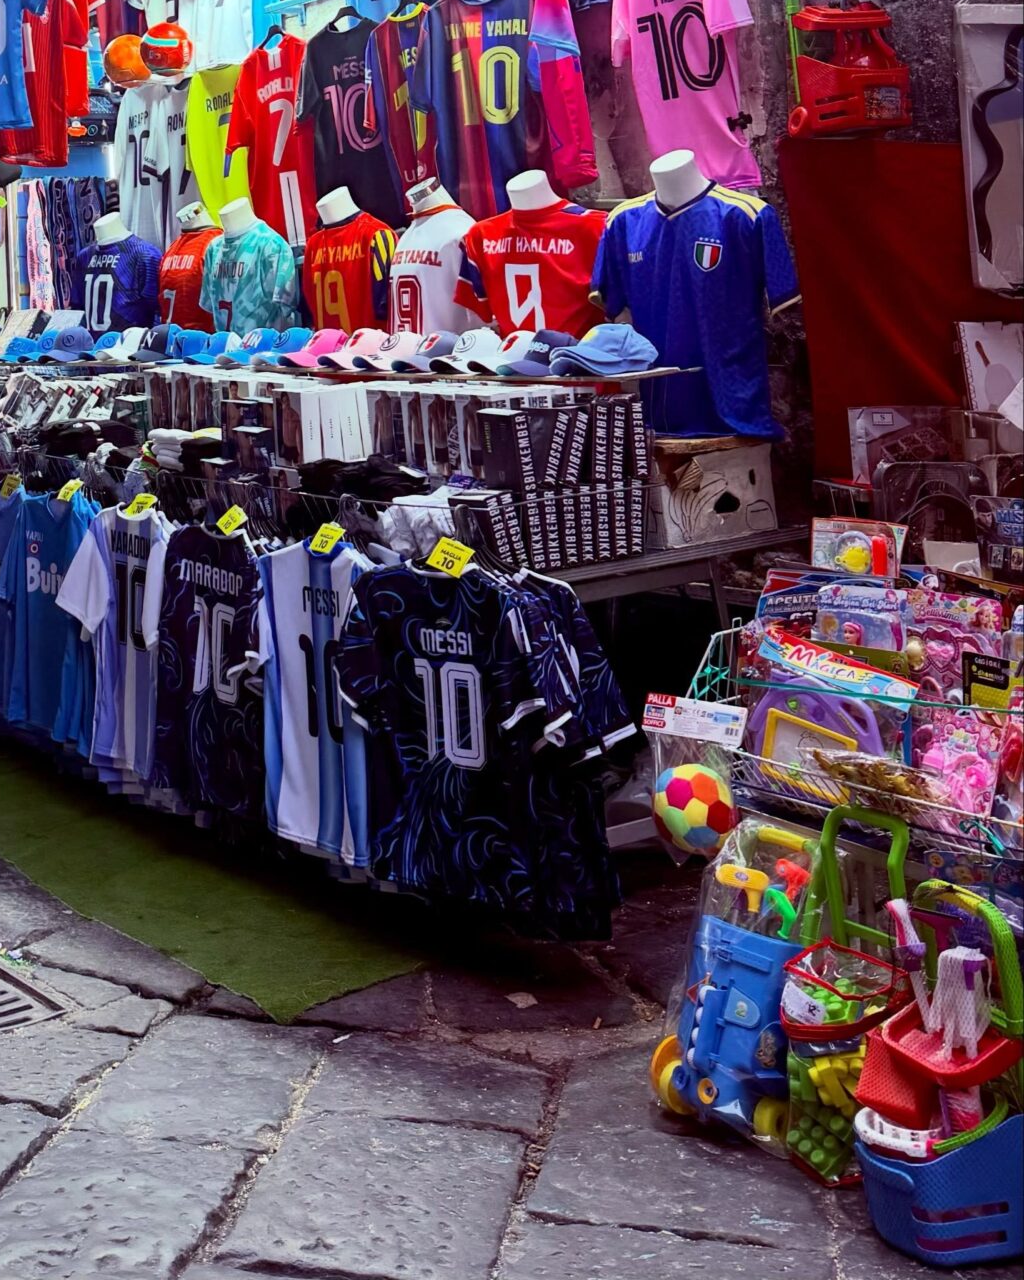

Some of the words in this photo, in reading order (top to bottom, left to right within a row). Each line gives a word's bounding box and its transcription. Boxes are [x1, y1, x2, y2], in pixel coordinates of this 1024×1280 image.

[486, 18, 528, 37] YAMAL
[637, 1, 727, 101] 10
[332, 61, 366, 81] MESS
[451, 45, 520, 126] 10
[206, 91, 233, 113] RONAL
[269, 98, 293, 166] 7
[323, 83, 383, 155] 10
[404, 250, 442, 268] YAMAL
[483, 236, 512, 255] BRAUT
[84, 273, 114, 332] 10
[163, 289, 176, 325] 7
[314, 270, 351, 336] 19
[504, 263, 546, 333] 9
[218, 300, 232, 332] 7
[142, 330, 158, 348] N
[440, 549, 462, 561] MAGLIA
[302, 585, 340, 618] MESSI
[914, 603, 961, 622] Bellissima
[193, 594, 239, 706] 10
[420, 628, 473, 656] MESSI
[414, 658, 487, 771] 10
[648, 693, 673, 706] PALLA
